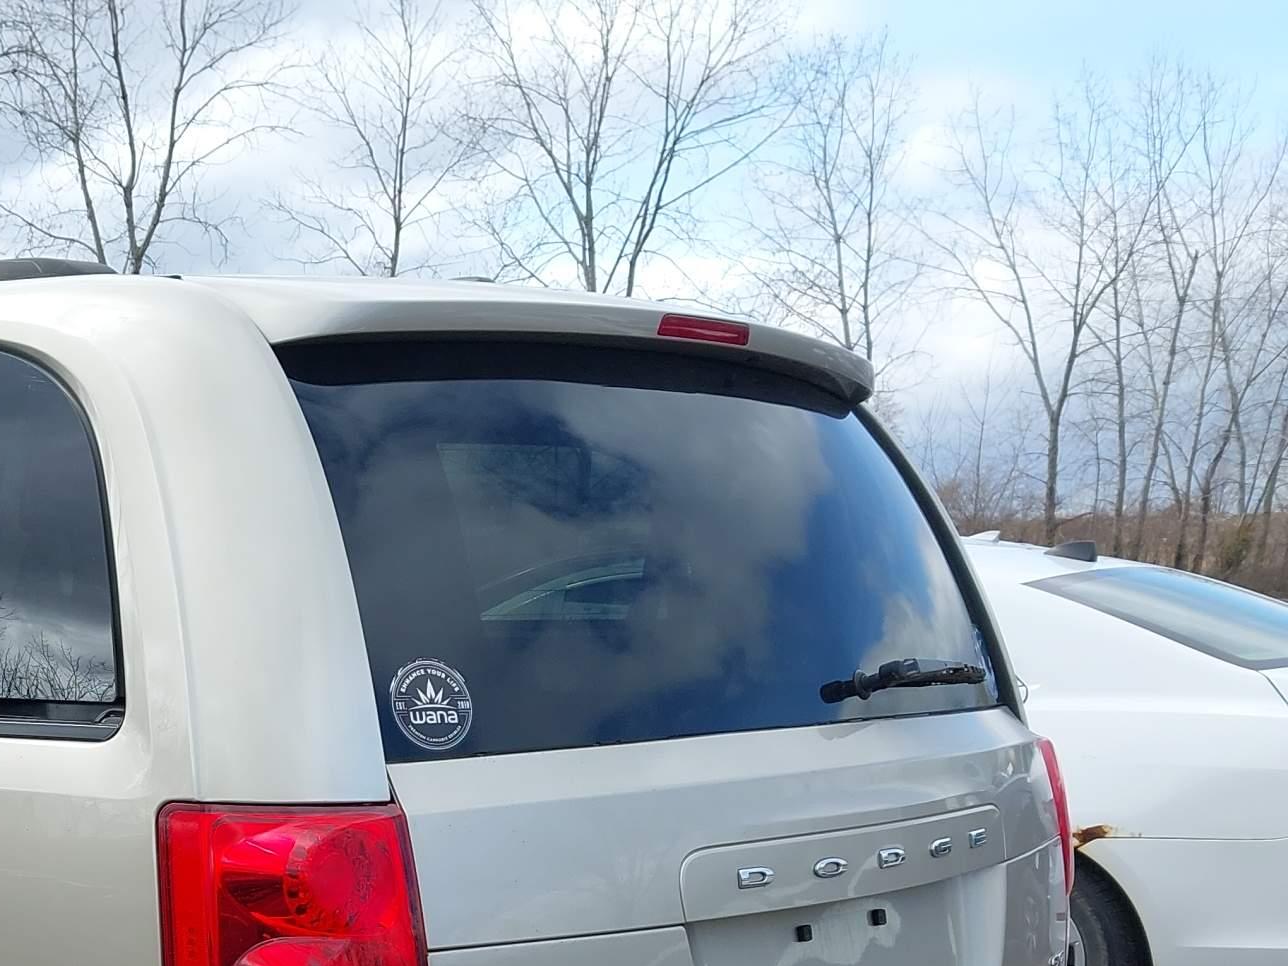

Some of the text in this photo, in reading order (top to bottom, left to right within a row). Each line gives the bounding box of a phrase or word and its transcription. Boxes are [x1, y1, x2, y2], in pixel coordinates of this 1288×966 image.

[400, 669, 460, 693] ENHANCE YOUR LIFE
[409, 710, 459, 724] wana
[736, 828, 988, 890] DODGE
